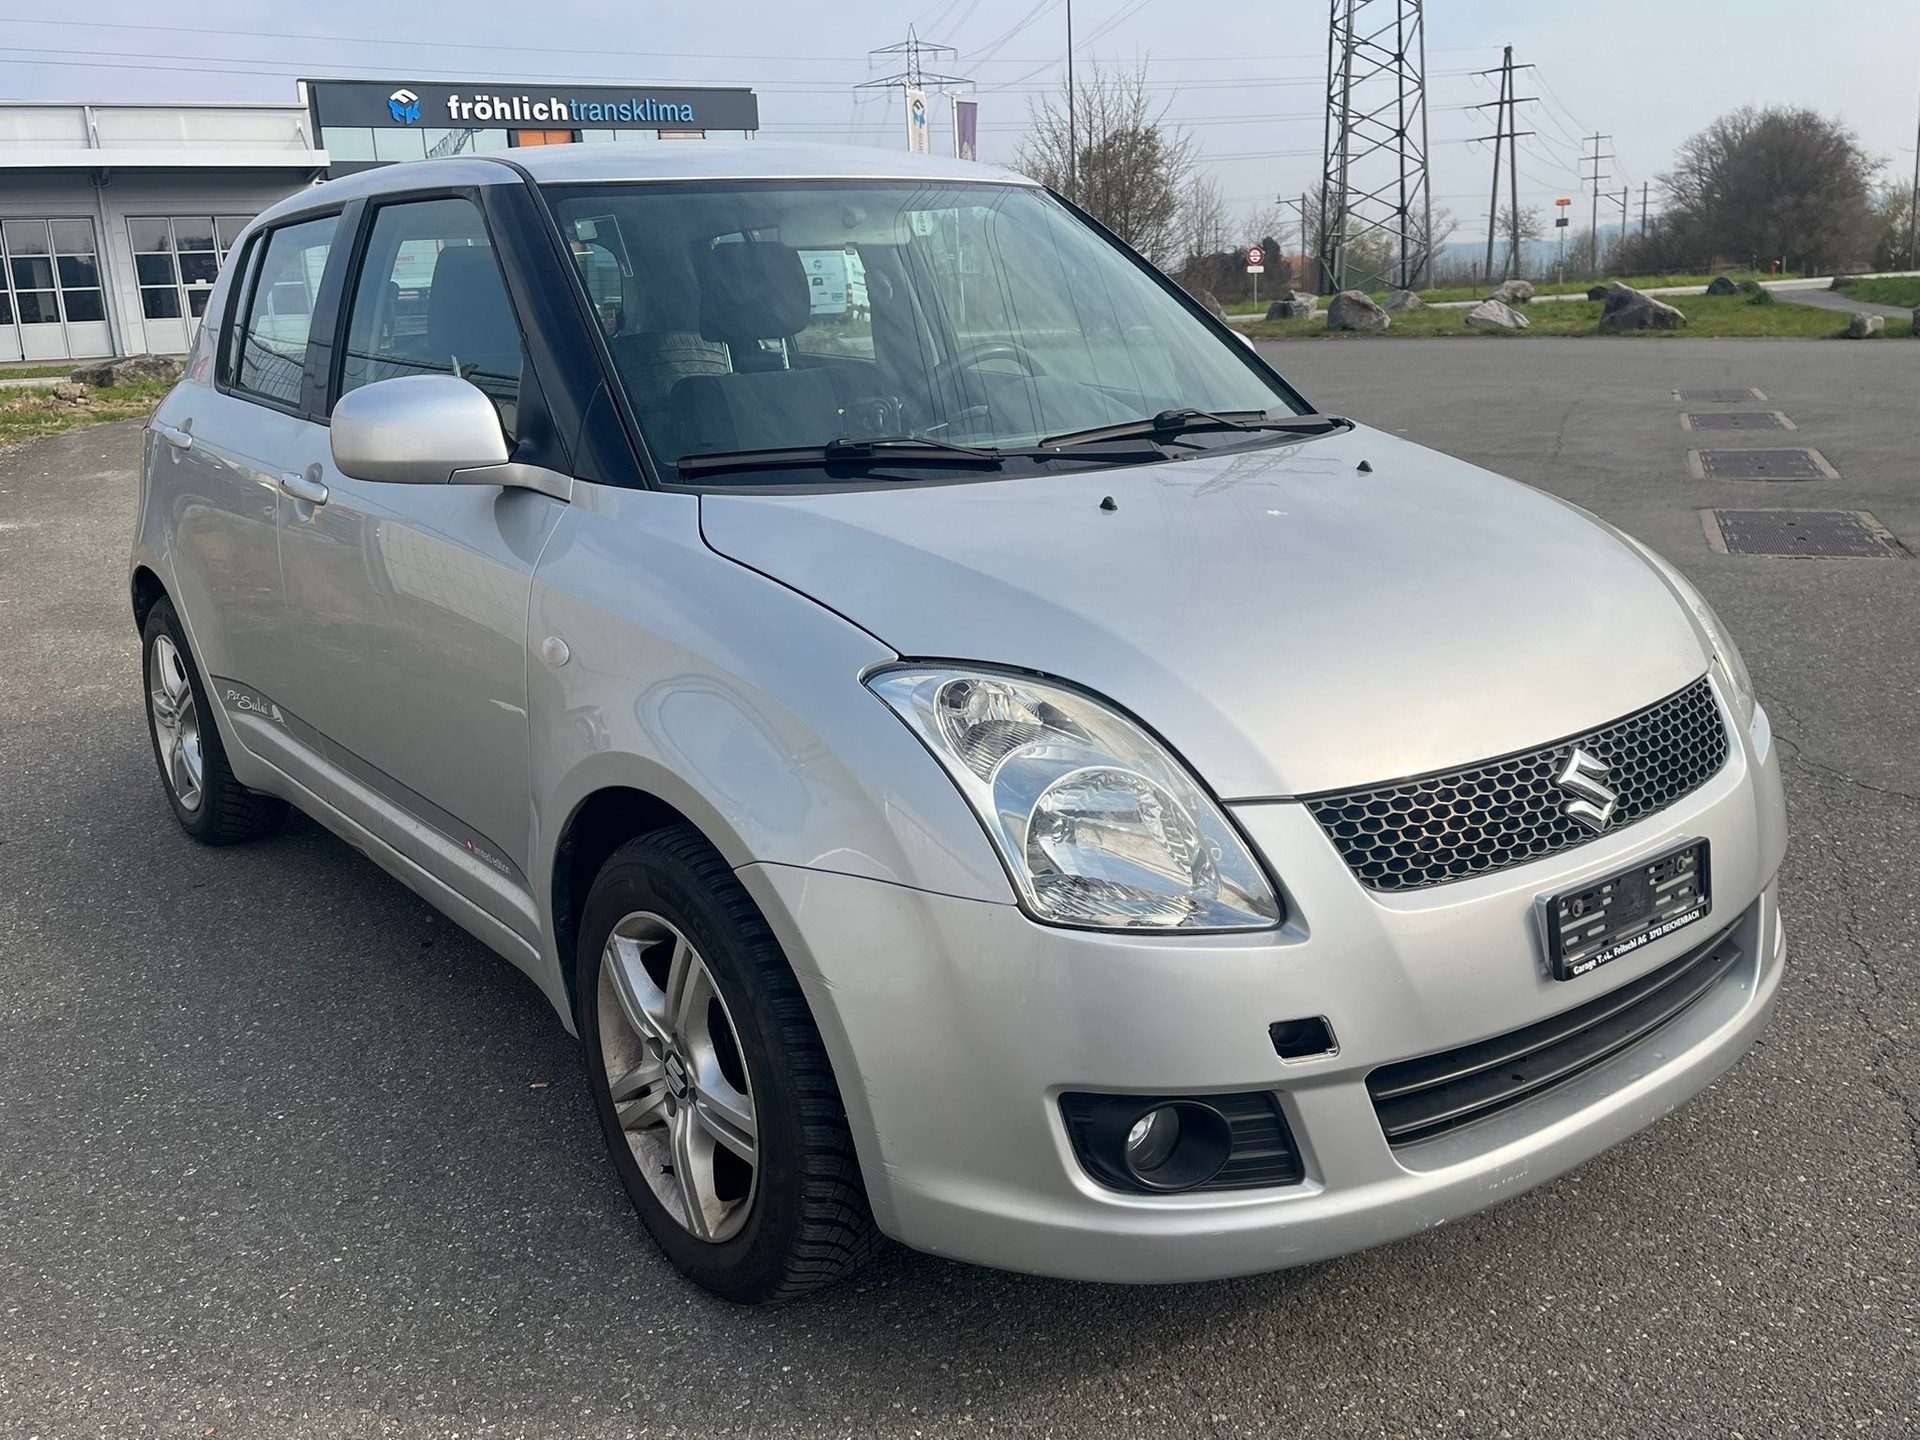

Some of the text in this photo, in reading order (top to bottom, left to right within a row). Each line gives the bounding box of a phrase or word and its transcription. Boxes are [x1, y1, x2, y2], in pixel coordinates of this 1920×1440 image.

[1573, 959, 1597, 975] Garage
[1637, 934, 1648, 946] AG
[1648, 927, 1663, 940] 3713
[1662, 910, 1700, 934] REICHENBACH
